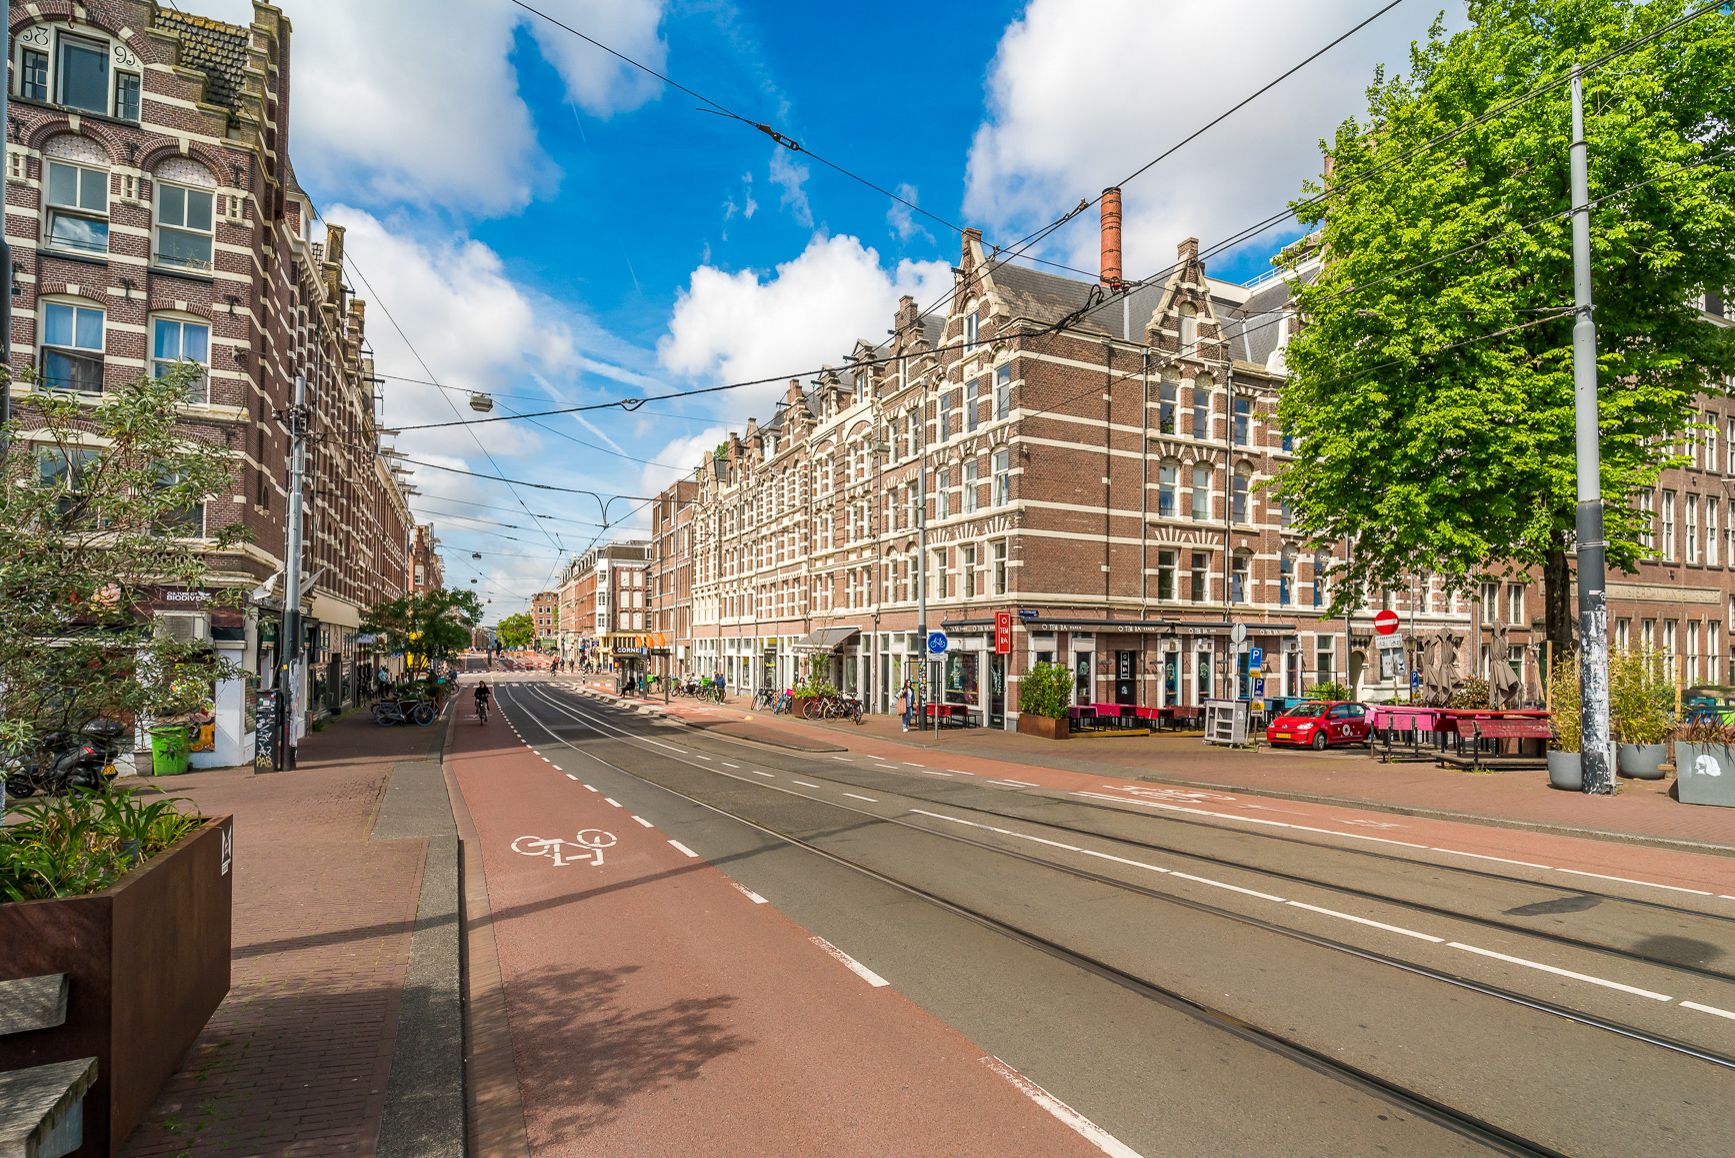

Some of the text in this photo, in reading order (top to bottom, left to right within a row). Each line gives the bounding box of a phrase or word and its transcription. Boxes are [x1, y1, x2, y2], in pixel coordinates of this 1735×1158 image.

[1253, 650, 1259, 660] P
[1412, 672, 1416, 680] P
[1256, 680, 1262, 689] P
